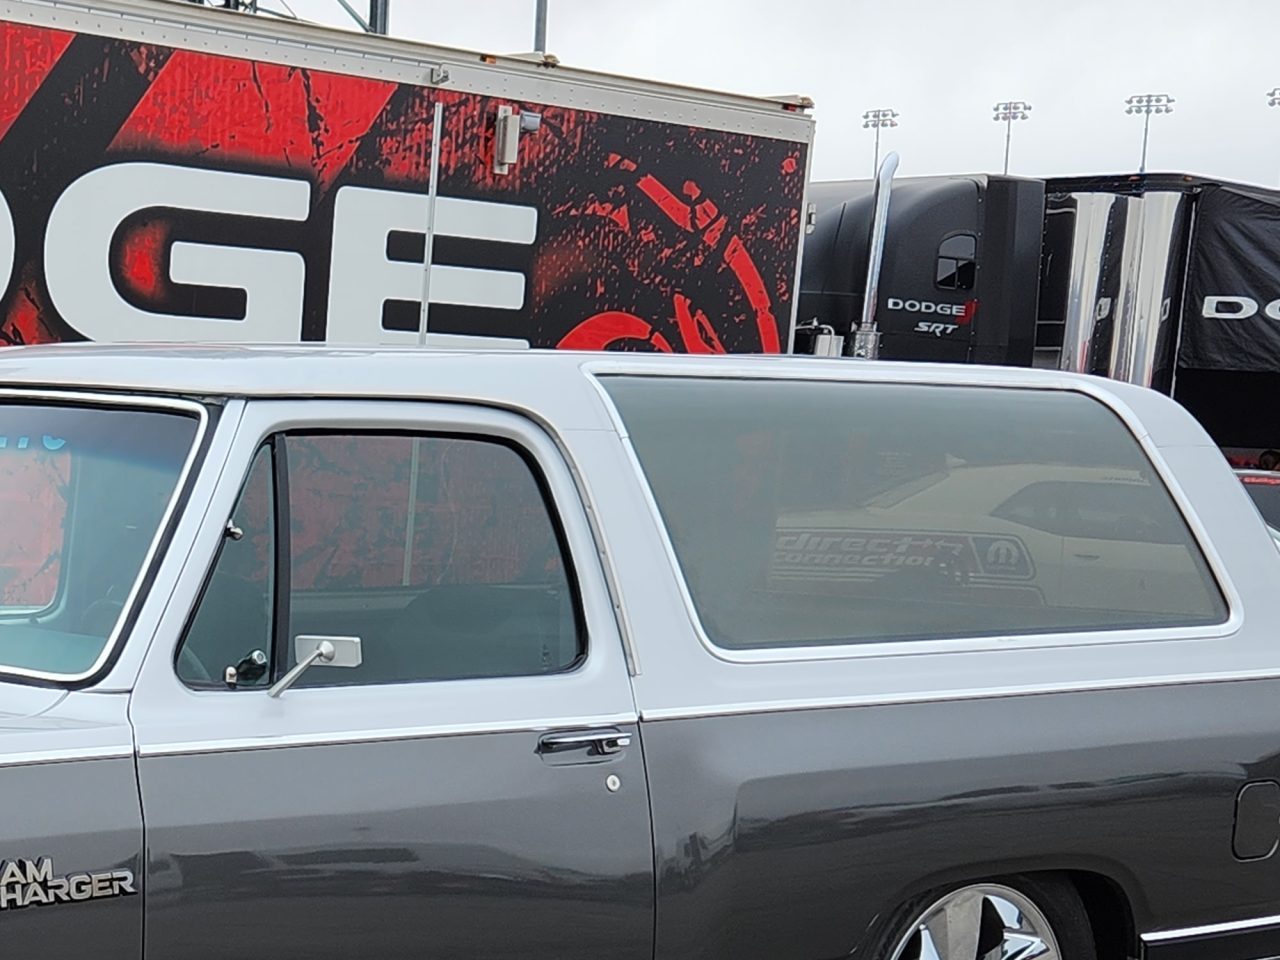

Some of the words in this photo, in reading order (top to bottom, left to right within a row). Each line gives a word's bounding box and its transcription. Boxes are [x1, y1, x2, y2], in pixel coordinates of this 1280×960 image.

[886, 298, 966, 316] DODGE
[1202, 296, 1280, 320] D
[914, 321, 959, 337] SRT
